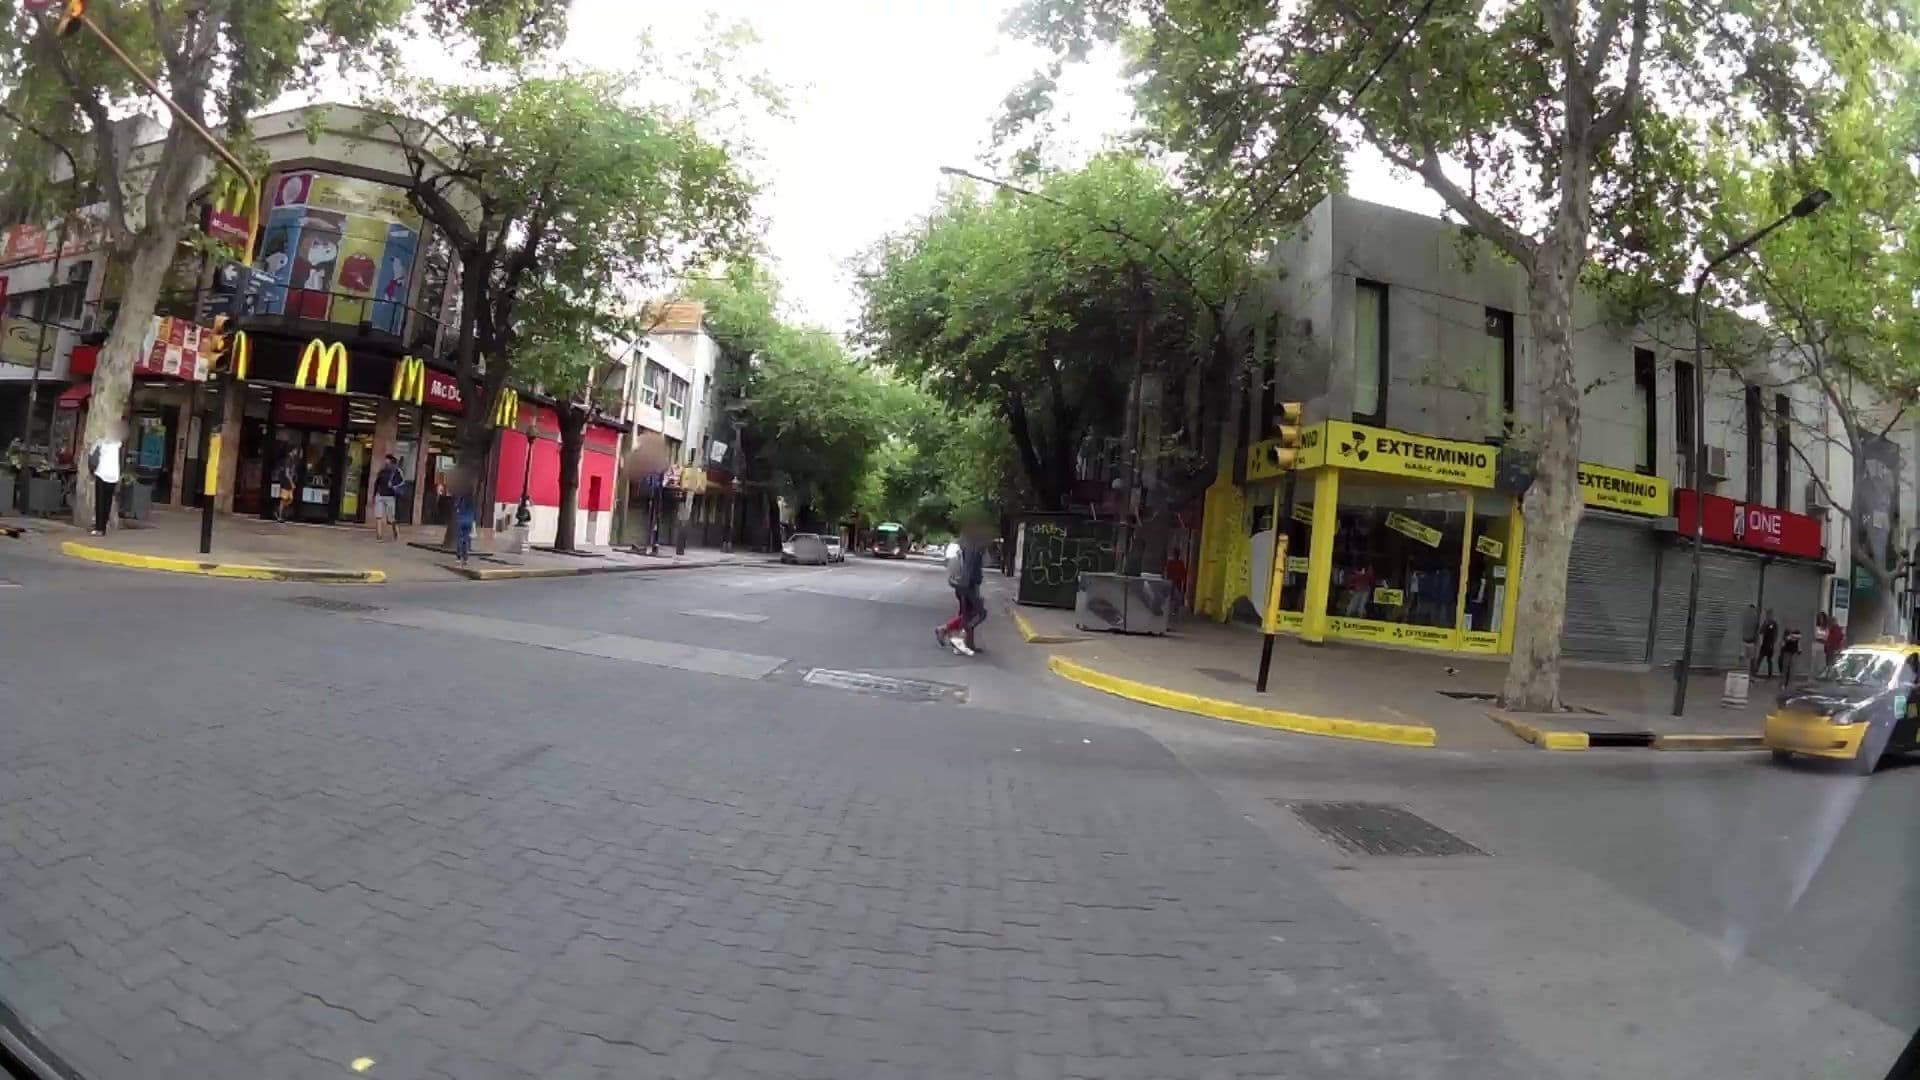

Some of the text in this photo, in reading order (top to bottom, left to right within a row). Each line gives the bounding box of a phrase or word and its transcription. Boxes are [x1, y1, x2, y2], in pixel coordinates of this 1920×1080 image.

[1376, 438, 1487, 468] EXTERMINIO
[1577, 472, 1657, 498] EXTERMINIO
[1749, 511, 1781, 534] ONE
